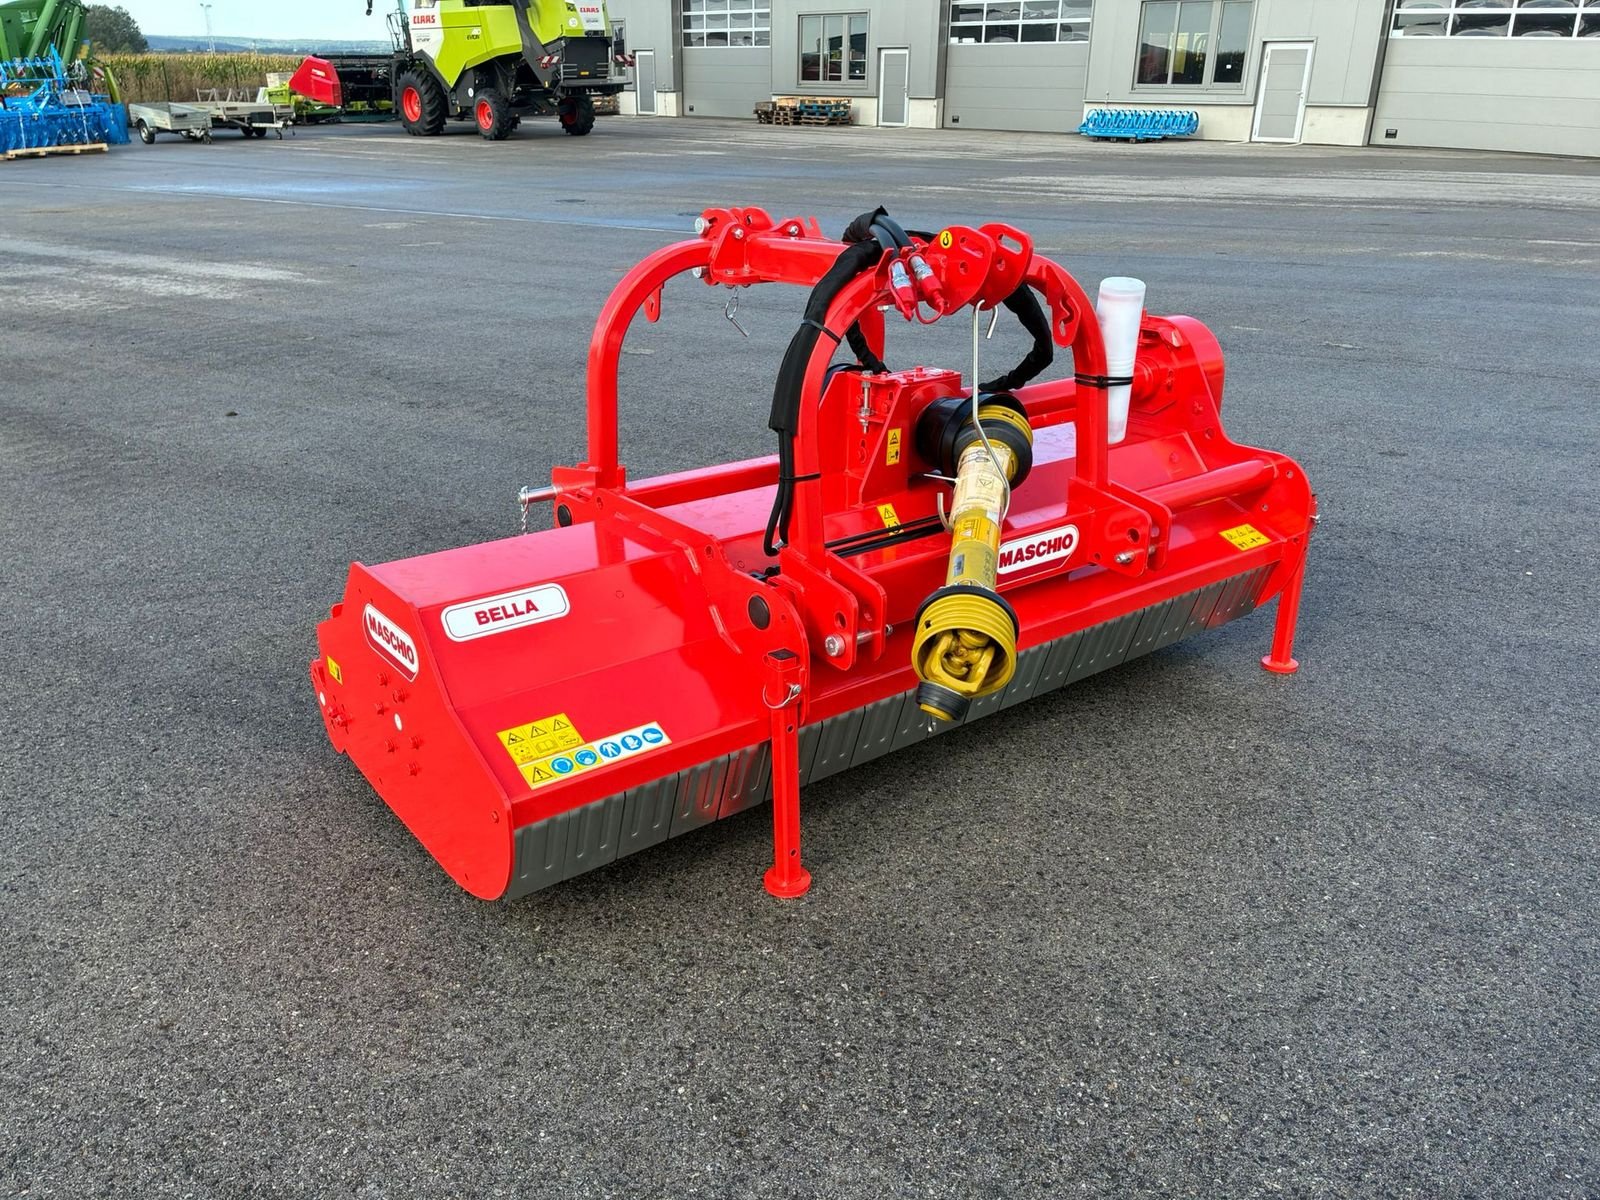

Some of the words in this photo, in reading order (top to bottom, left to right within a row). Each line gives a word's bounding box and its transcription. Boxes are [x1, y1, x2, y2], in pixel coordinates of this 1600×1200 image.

[413, 15, 436, 24] CLAAS
[998, 533, 1074, 569] MASCHIO
[474, 599, 539, 626] BELLA
[367, 612, 415, 665] MASCHIO
